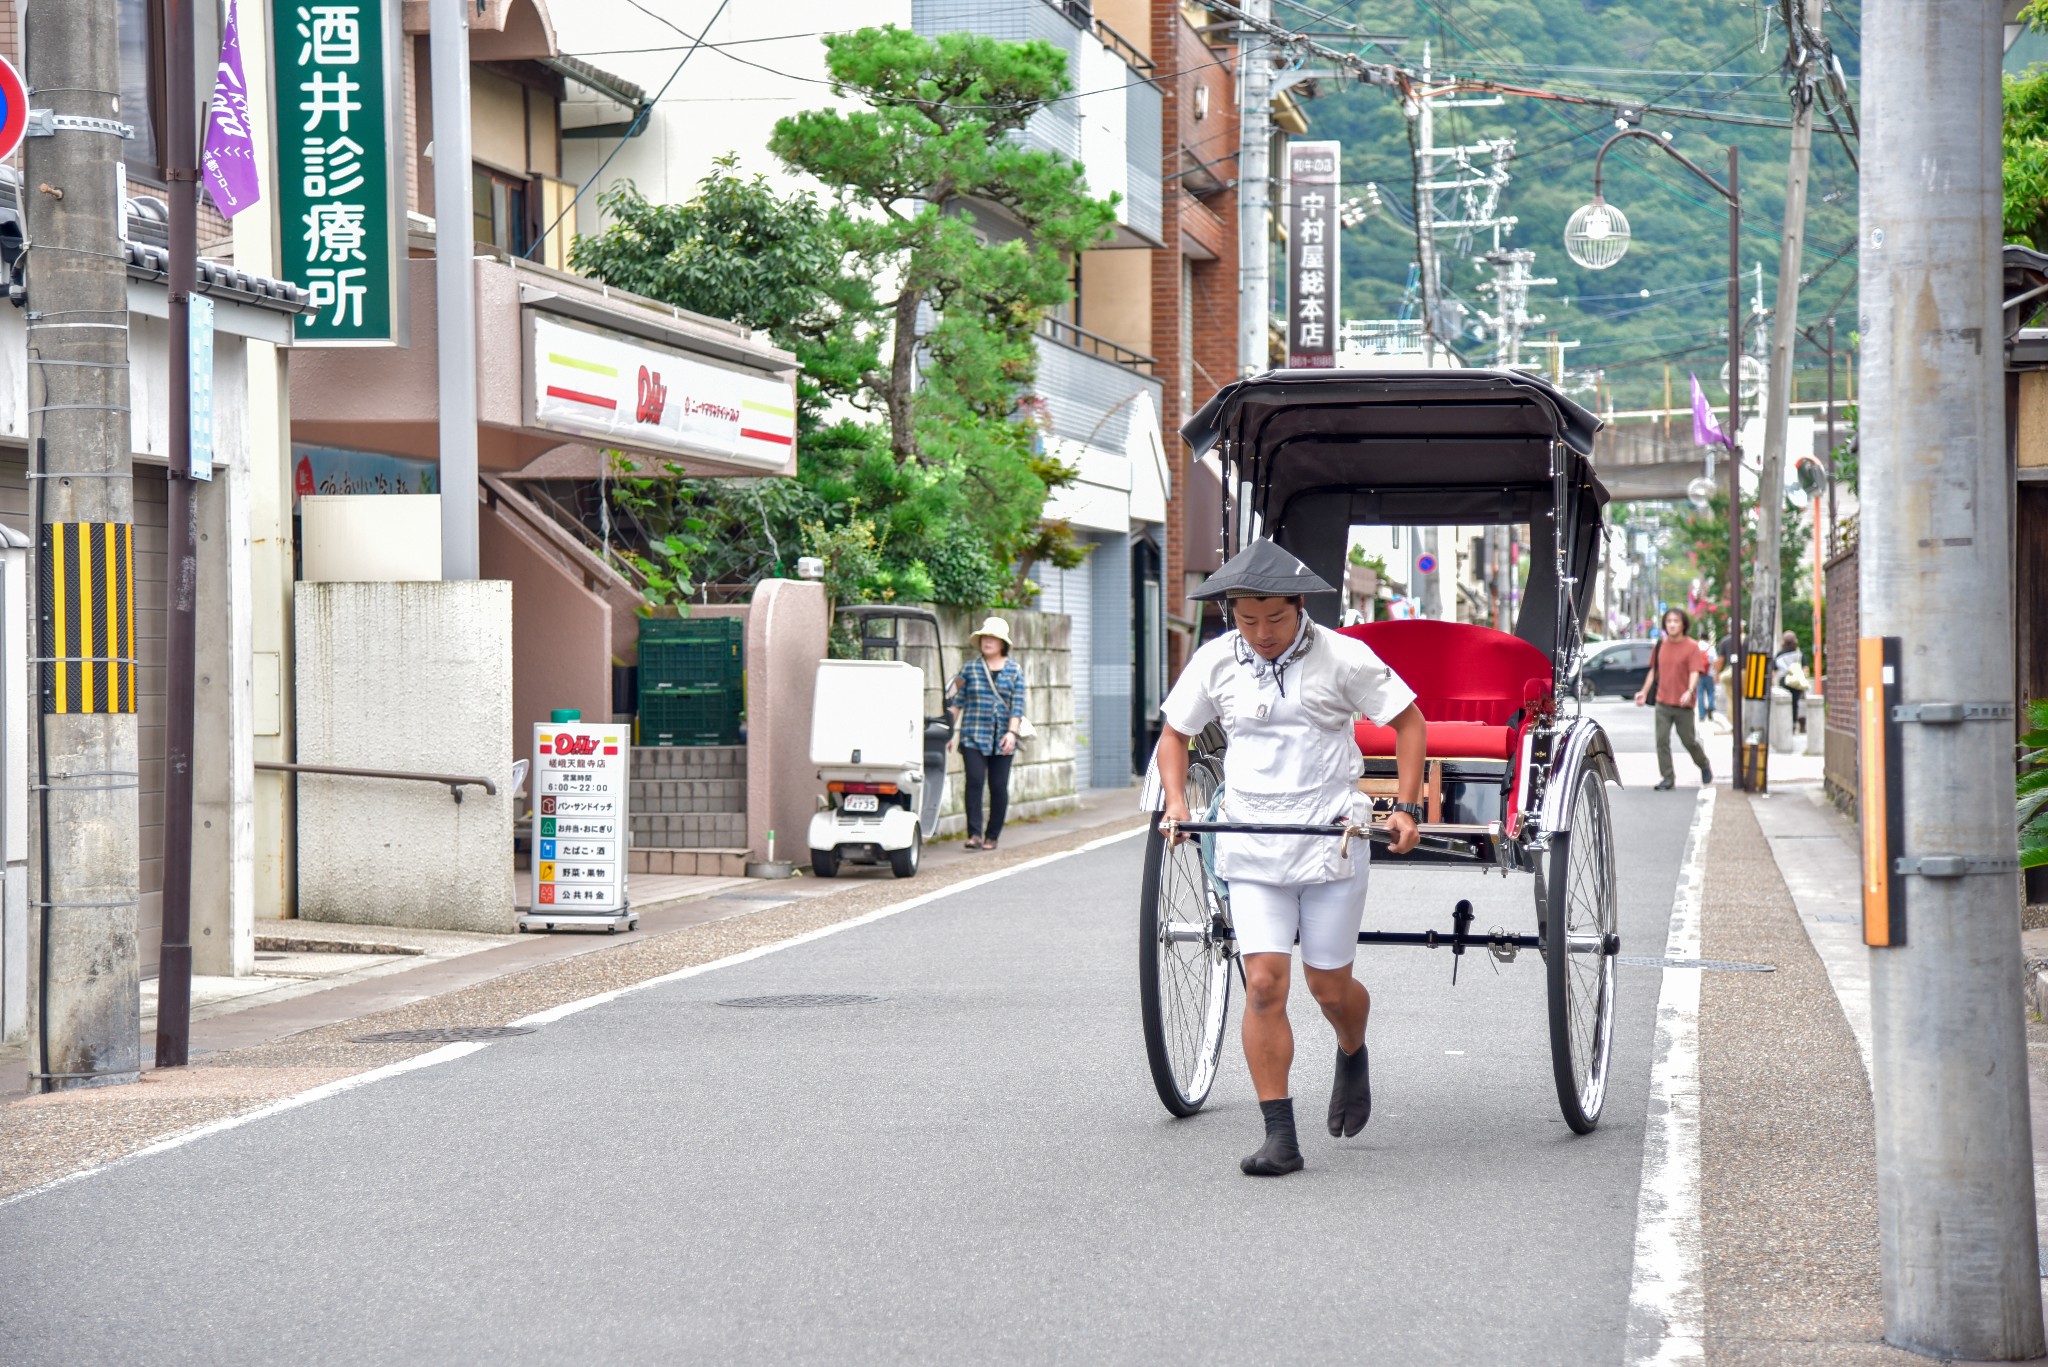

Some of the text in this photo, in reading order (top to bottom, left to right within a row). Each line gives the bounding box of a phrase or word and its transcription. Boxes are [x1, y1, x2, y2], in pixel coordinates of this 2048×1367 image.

[203, 150, 238, 206] 京都フローラ
[297, 6, 367, 327] 酒井診療所
[1298, 191, 1326, 348] 中村屋総本店
[554, 733, 600, 756] DAILY
[549, 758, 606, 769] 嵯峨天龍寺店
[562, 774, 592, 782] 営業時間
[562, 890, 605, 900] 公共料金
